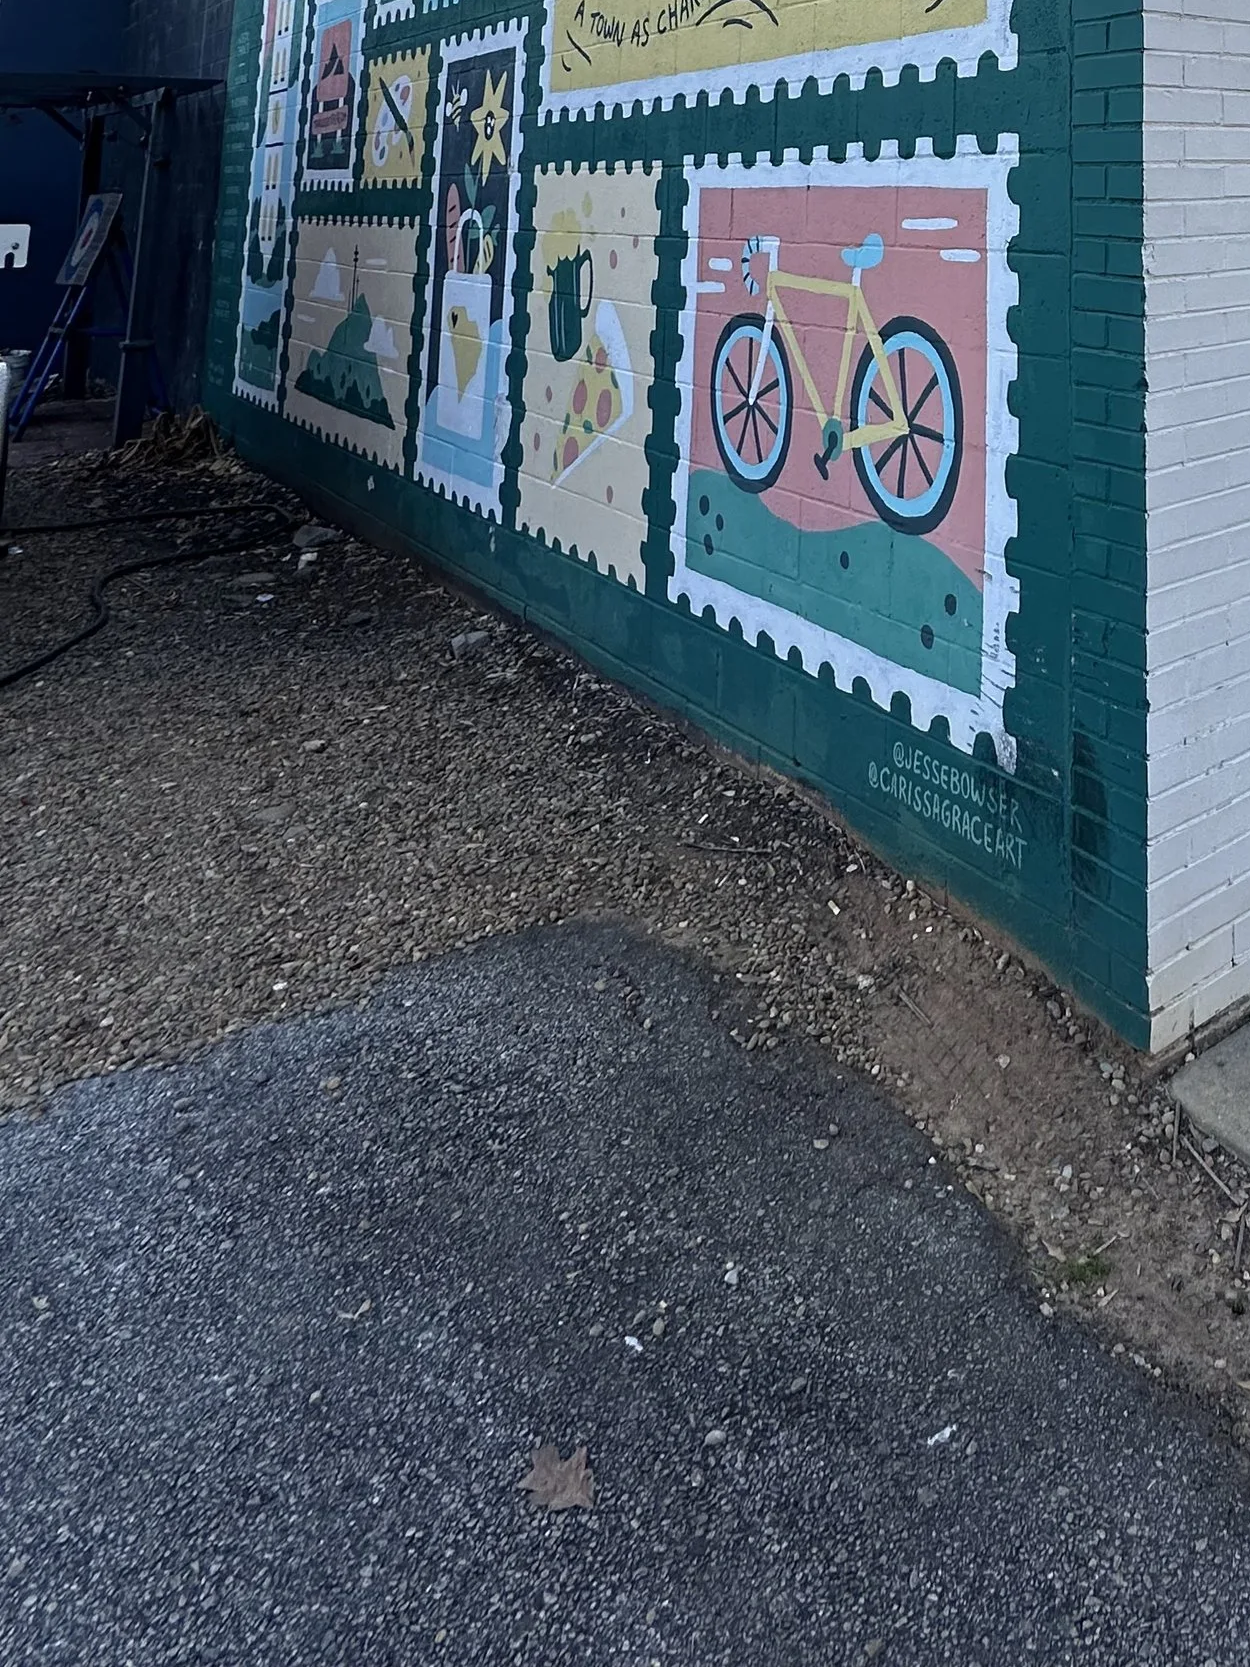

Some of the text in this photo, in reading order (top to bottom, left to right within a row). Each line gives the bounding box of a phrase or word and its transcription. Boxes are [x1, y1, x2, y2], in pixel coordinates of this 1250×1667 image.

[574, 0, 586, 27] A
[590, 12, 625, 47] TOWN
[631, 18, 650, 47] AS
[868, 761, 1028, 870] @CARISSAGRACEART
[893, 742, 1022, 833] @JESSEBOWSER
